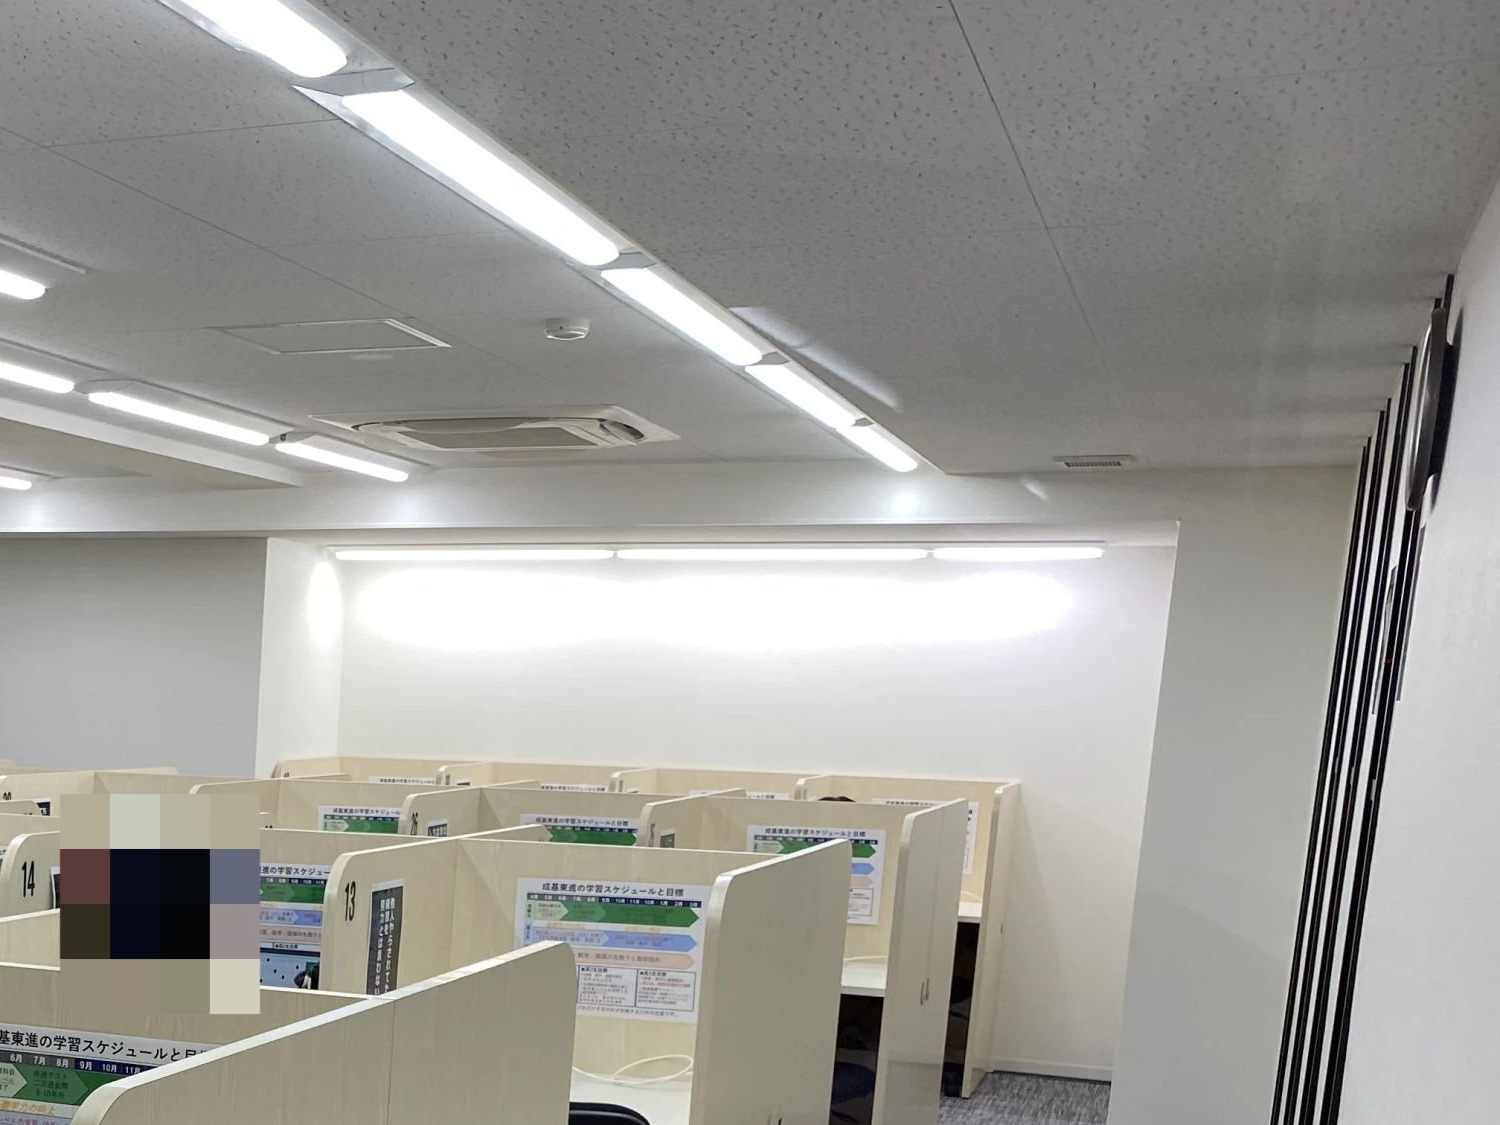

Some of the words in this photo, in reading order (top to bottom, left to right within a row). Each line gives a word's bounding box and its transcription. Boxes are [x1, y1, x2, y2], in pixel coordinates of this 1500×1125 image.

[22, 860, 36, 898] 14
[260, 866, 330, 876] 進の学習スケジュー
[542, 882, 684, 897] 成基東進の学習スケジュールと目標
[344, 881, 357, 922] 13
[33, 1055, 46, 1066] 7月
[56, 1058, 69, 1068] 8月
[79, 1061, 92, 1071] 9月
[102, 1063, 117, 1073] 10月
